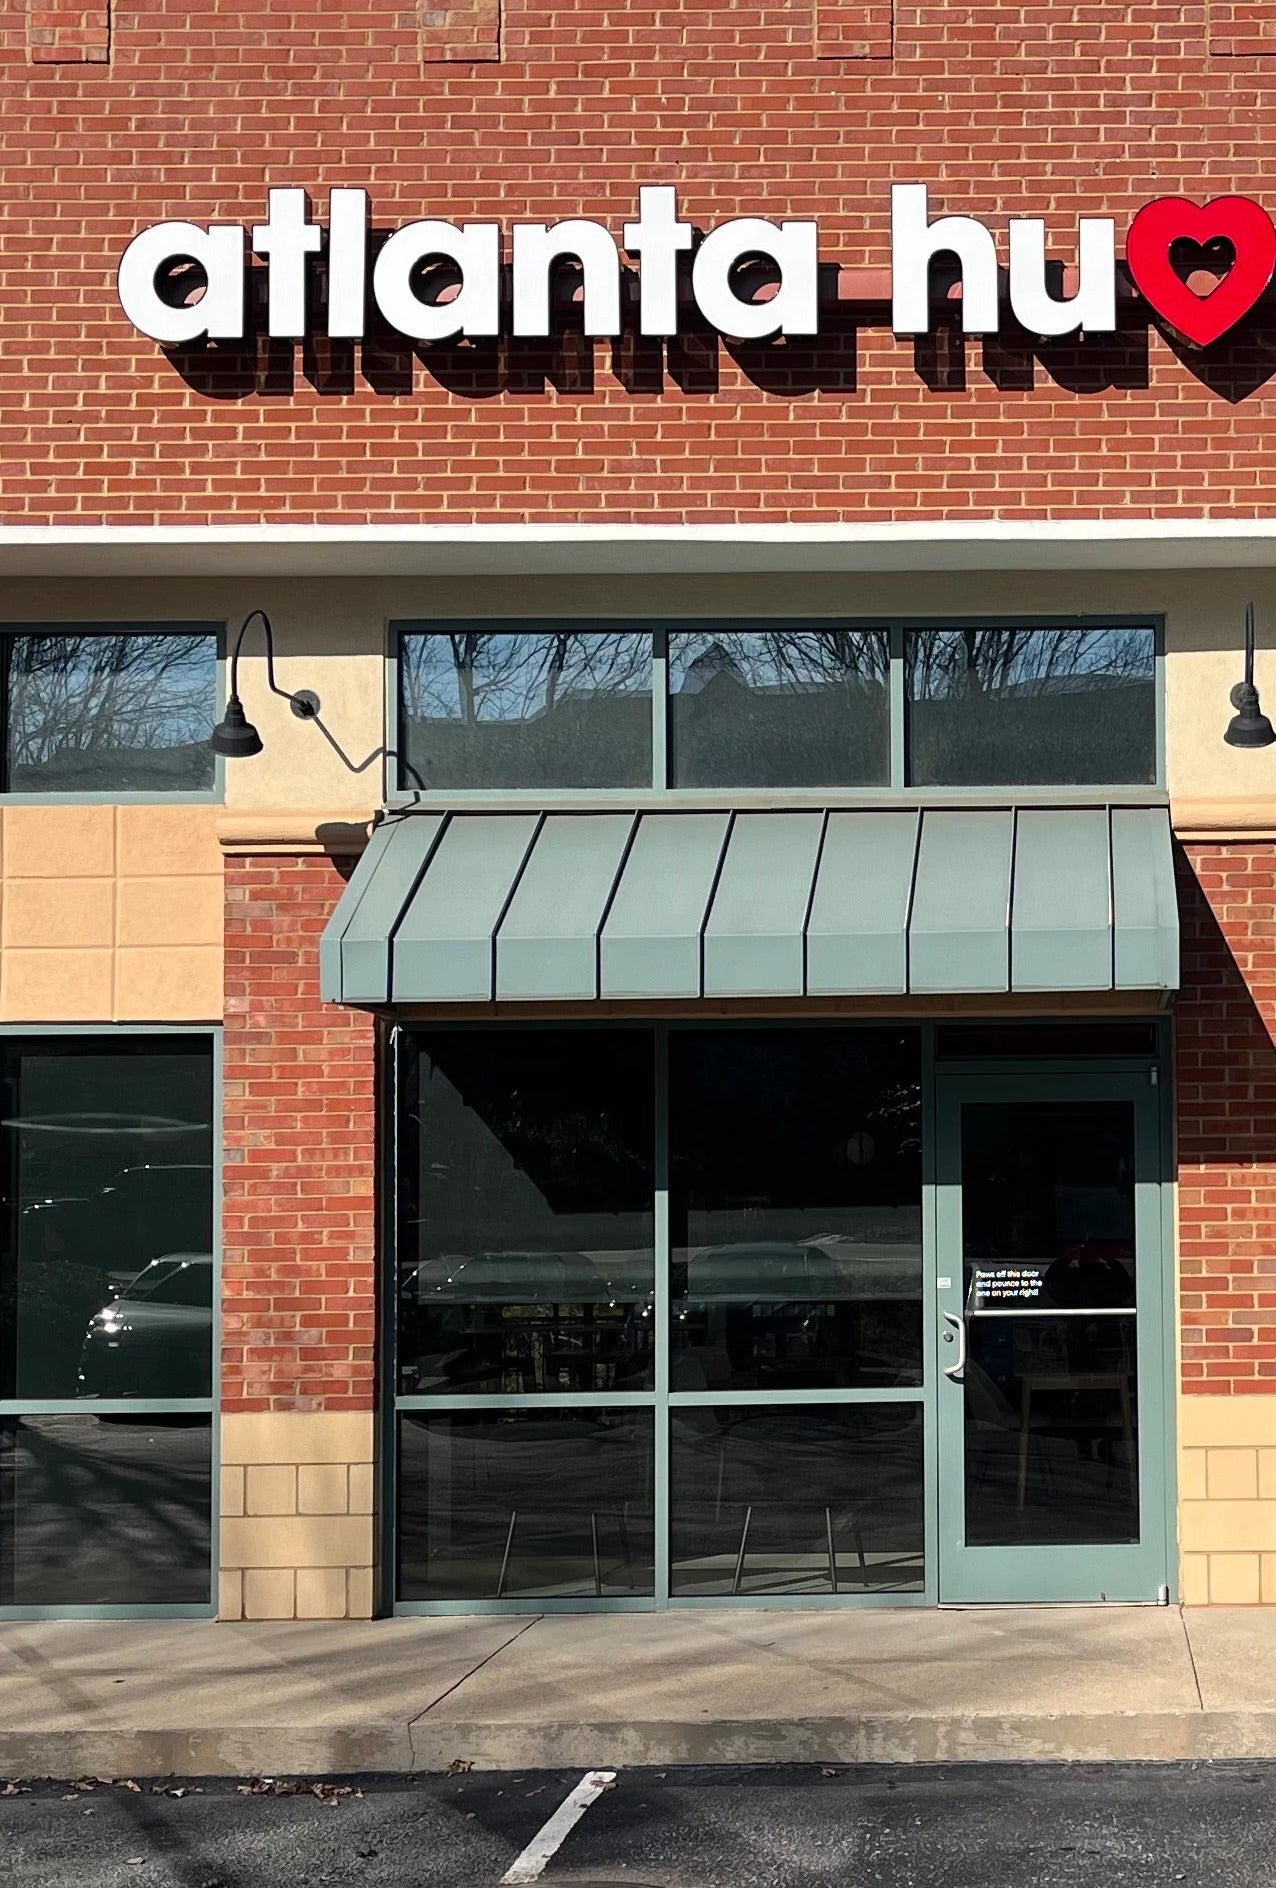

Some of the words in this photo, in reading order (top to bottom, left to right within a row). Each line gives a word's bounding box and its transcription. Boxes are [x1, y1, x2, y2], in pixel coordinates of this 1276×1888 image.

[117, 184, 818, 342] atlanta
[975, 1270, 995, 1278] Paws
[996, 1270, 1006, 1278] off
[992, 1280, 1020, 1288] pounce
[1002, 1289, 1018, 1298] your
